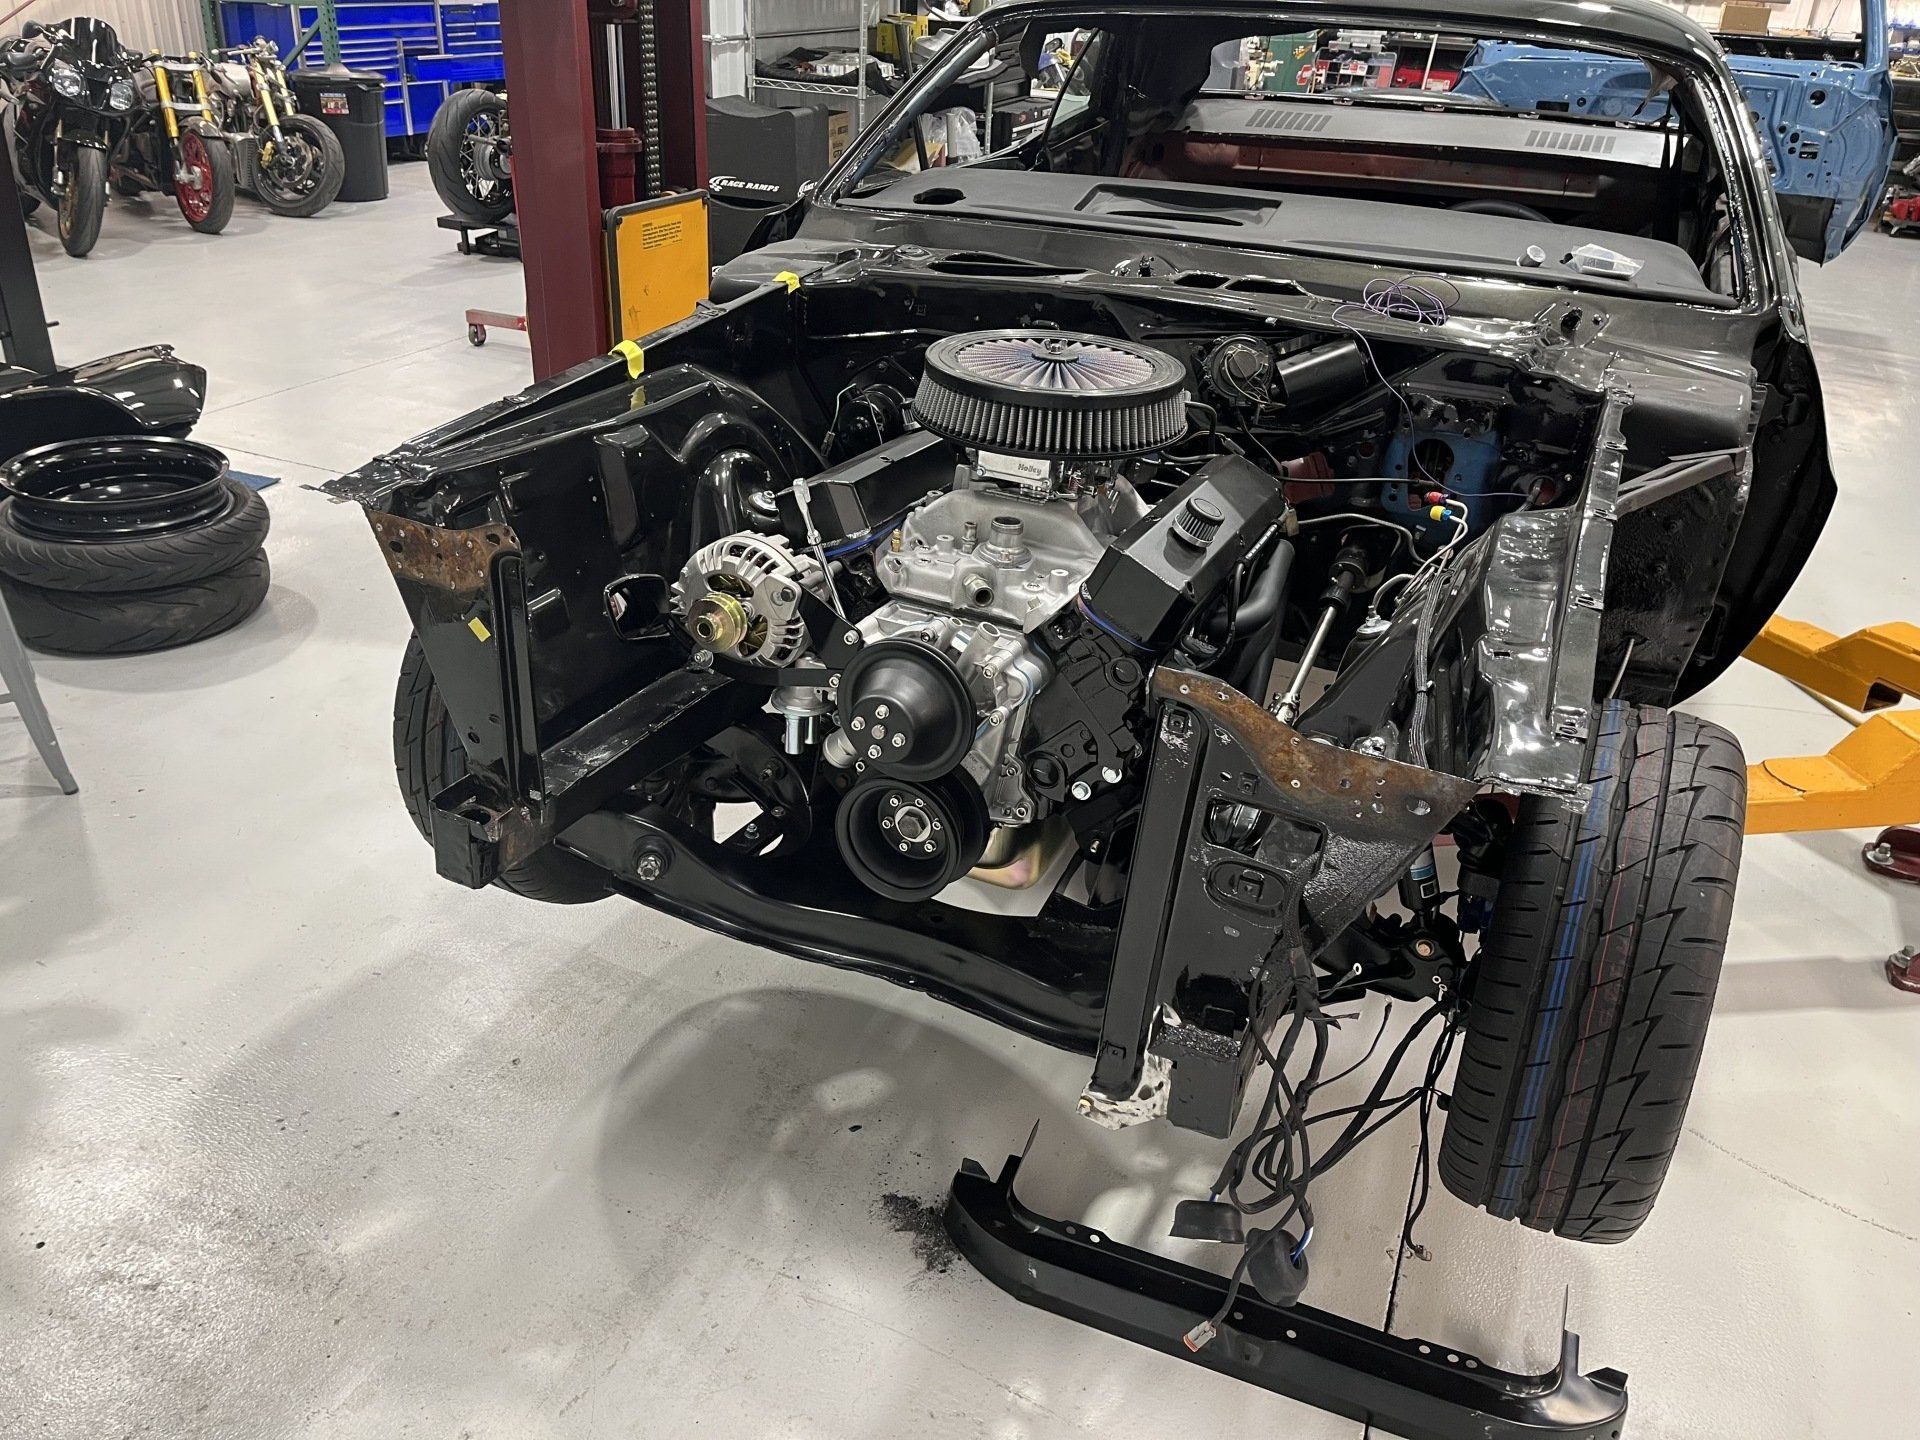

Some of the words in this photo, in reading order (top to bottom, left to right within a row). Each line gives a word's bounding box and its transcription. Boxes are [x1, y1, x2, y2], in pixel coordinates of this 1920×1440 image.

[720, 180, 745, 188] RACE
[745, 183, 780, 192] RAMPS
[1018, 463, 1042, 476] Holley
